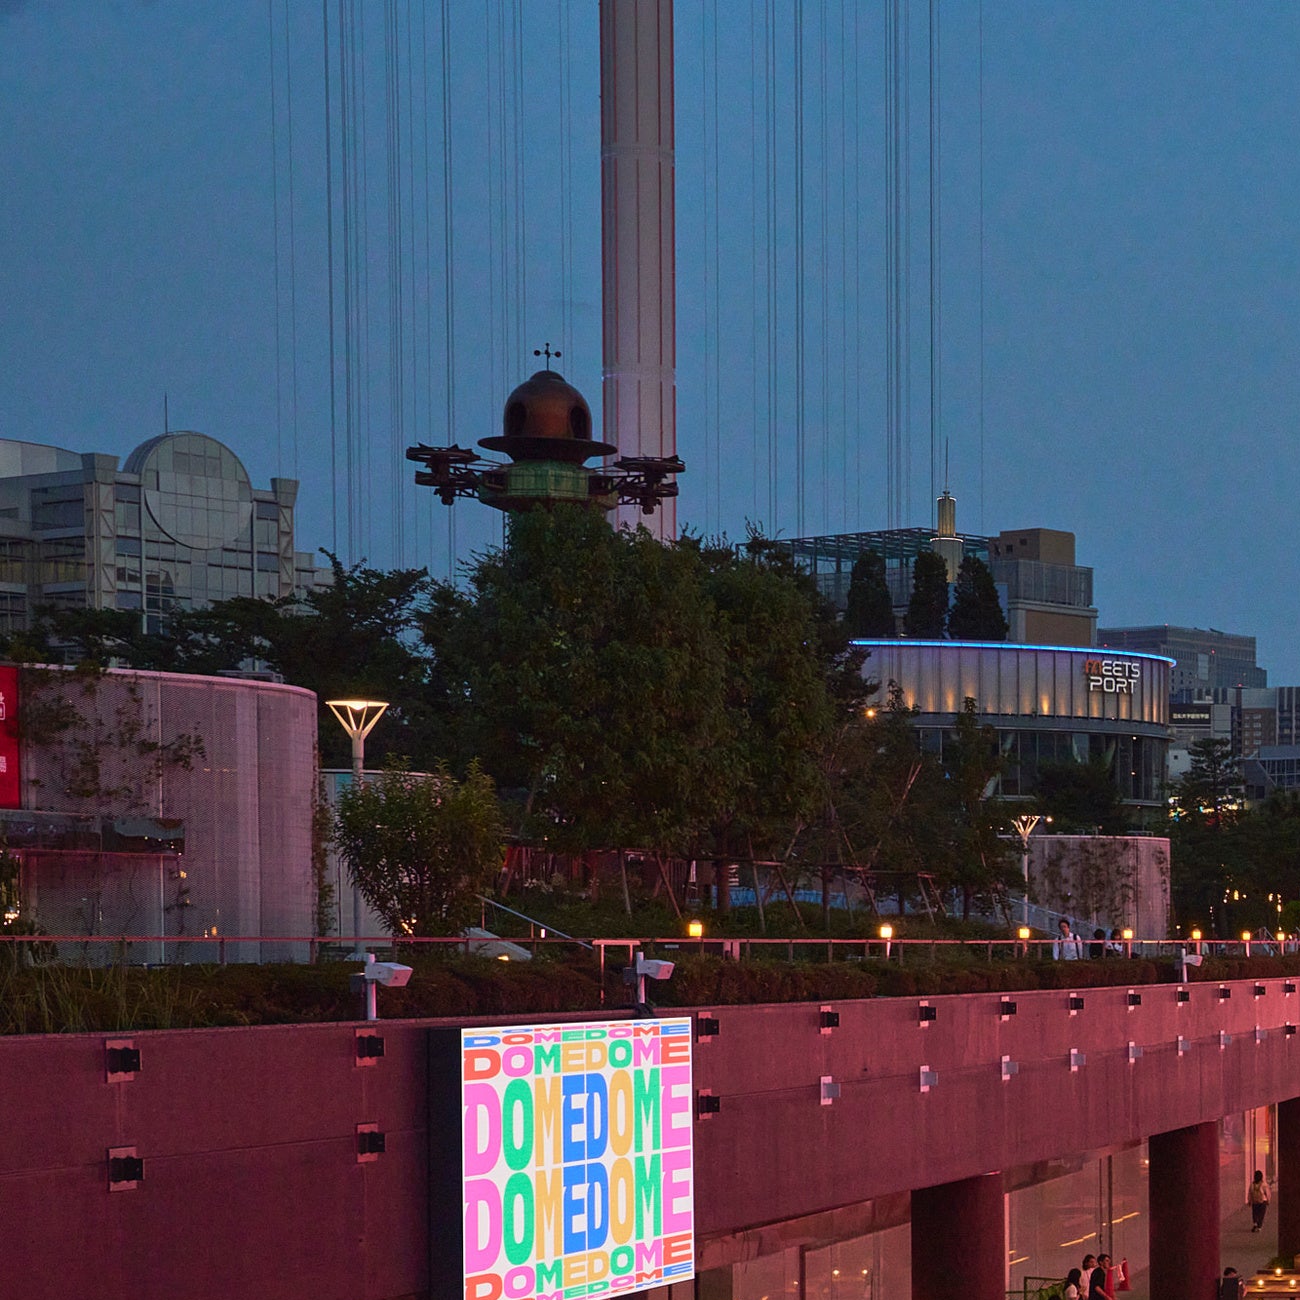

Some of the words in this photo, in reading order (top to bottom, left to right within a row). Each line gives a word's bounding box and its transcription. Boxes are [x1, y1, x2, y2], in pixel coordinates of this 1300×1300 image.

[1086, 659, 1140, 677] MEETS
[1090, 676, 1137, 694] PORT
[463, 1024, 690, 1048] DOMEDOME
[464, 1036, 690, 1081] DOMEDOME
[464, 1065, 691, 1177] DOMEDOME
[465, 1149, 692, 1274] DOMEDOME
